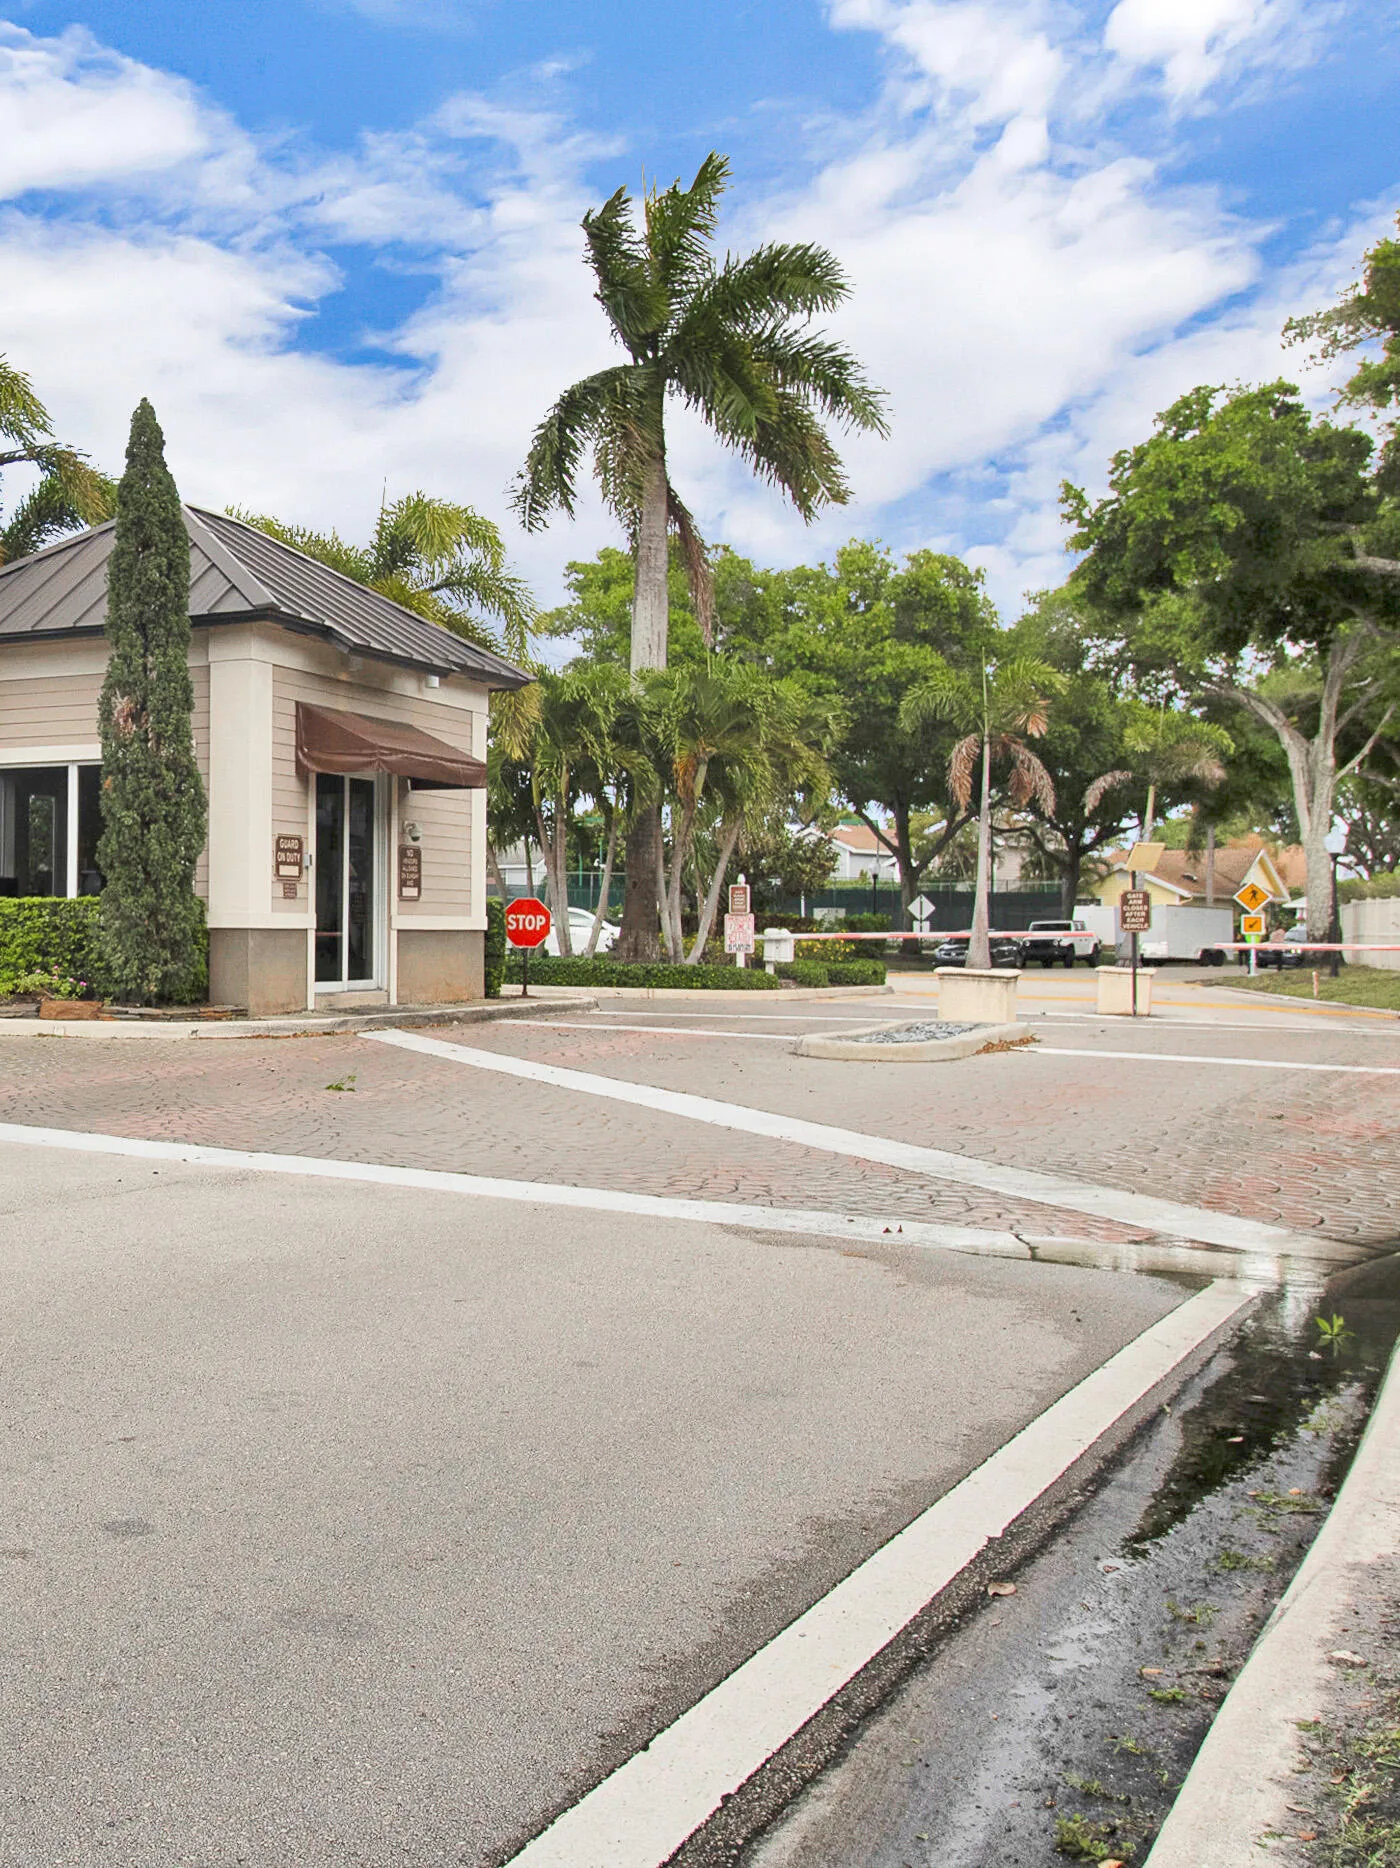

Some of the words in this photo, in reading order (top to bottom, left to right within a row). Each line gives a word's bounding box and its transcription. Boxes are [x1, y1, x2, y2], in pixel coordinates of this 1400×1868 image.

[280, 838, 298, 849] GUARD
[278, 852, 286, 862] ON
[287, 852, 300, 862] DUTY
[508, 914, 546, 930] STOP
